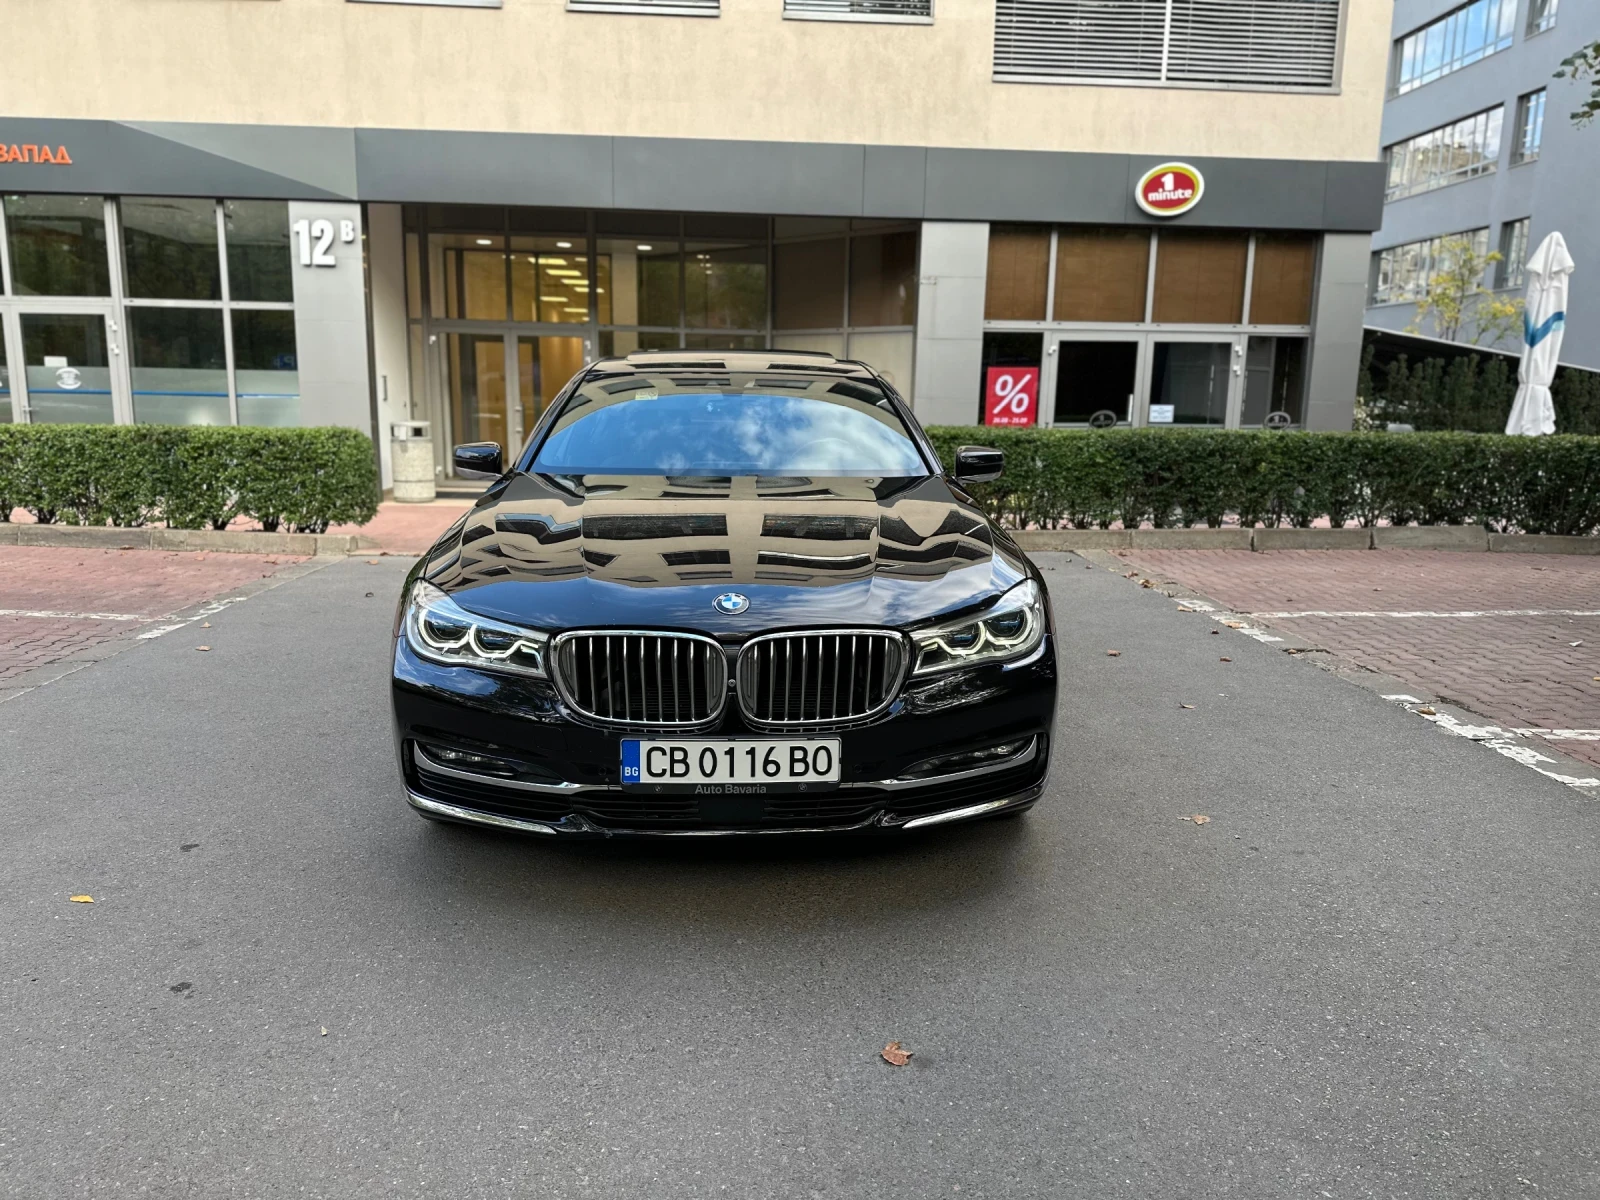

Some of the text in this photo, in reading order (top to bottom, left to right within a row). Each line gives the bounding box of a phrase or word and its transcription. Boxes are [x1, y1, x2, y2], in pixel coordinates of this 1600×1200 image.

[1161, 173, 1174, 191] 1
[1148, 188, 1193, 201] minute
[992, 373, 1032, 414] %
[646, 745, 690, 778] CB
[698, 746, 781, 778] 0116
[624, 766, 639, 777] BG
[694, 784, 767, 795] Auto Bavaria
